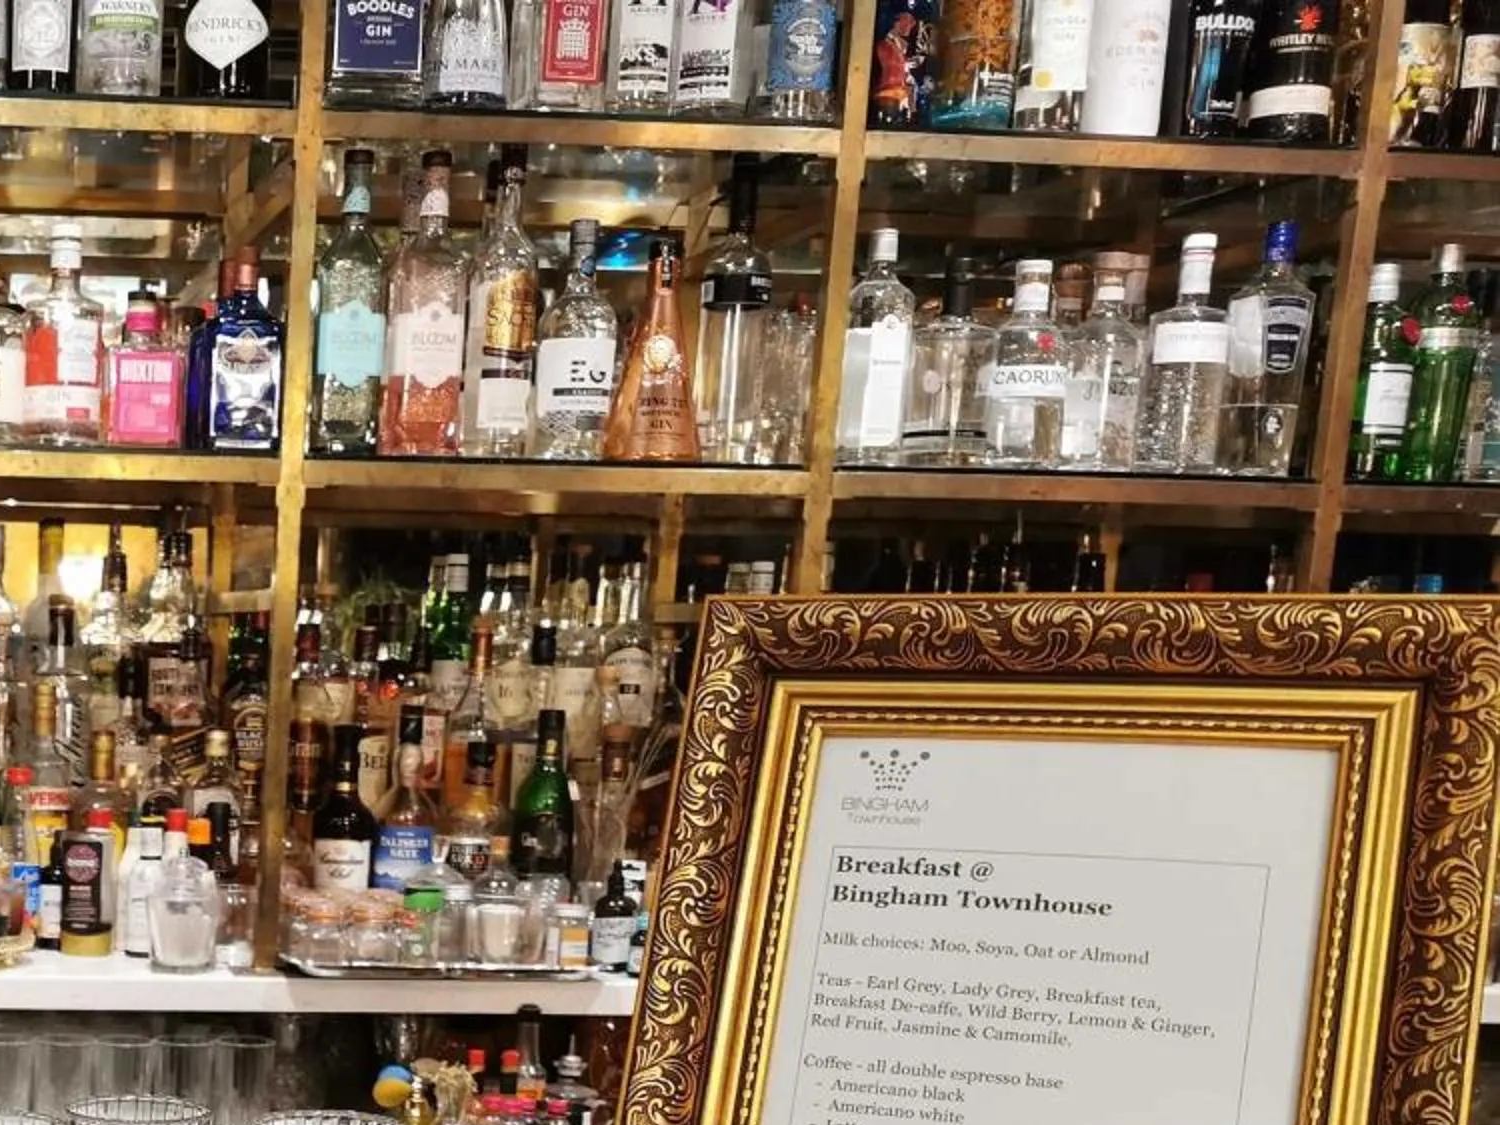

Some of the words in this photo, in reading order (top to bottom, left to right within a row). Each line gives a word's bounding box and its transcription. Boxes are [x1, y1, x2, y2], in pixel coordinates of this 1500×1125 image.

[347, 0, 415, 19] BOODLES
[563, 4, 590, 17] GIN
[366, 24, 393, 37] GIN
[841, 797, 930, 813] BINGHAM
[847, 812, 921, 826] Townhouse
[836, 855, 963, 877] Breakfast
[969, 861, 995, 882] @
[832, 884, 949, 908] Bingham
[956, 889, 1113, 917] Townhouse
[823, 932, 858, 947] Milk
[861, 933, 925, 951] choices:
[1024, 943, 1053, 959] Oat
[1057, 947, 1076, 961] or
[1080, 946, 1150, 966] Almond
[817, 971, 852, 988] Teas
[867, 975, 900, 991] Earl
[952, 980, 993, 1000] Lady
[1046, 986, 1125, 1007] Breakfast
[1131, 994, 1162, 1012] tea,
[811, 1013, 841, 1028] Red
[891, 1019, 962, 1038] Jasmine
[964, 1025, 978, 1039] &
[814, 992, 886, 1011] Breakfast
[968, 1003, 1007, 1020] Wild
[1068, 1010, 1128, 1030] Lemon
[1131, 1016, 1146, 1031] &
[1151, 1017, 1216, 1039] Ginger,
[803, 1053, 852, 1072] Coffee
[867, 1059, 887, 1074] all
[891, 1061, 947, 1081] double
[950, 1069, 1022, 1086] espresso
[1025, 1072, 1064, 1090] base
[831, 1078, 918, 1099] Americano
[922, 1082, 965, 1103] black
[828, 1099, 916, 1120] Americano
[919, 1104, 965, 1125] white
